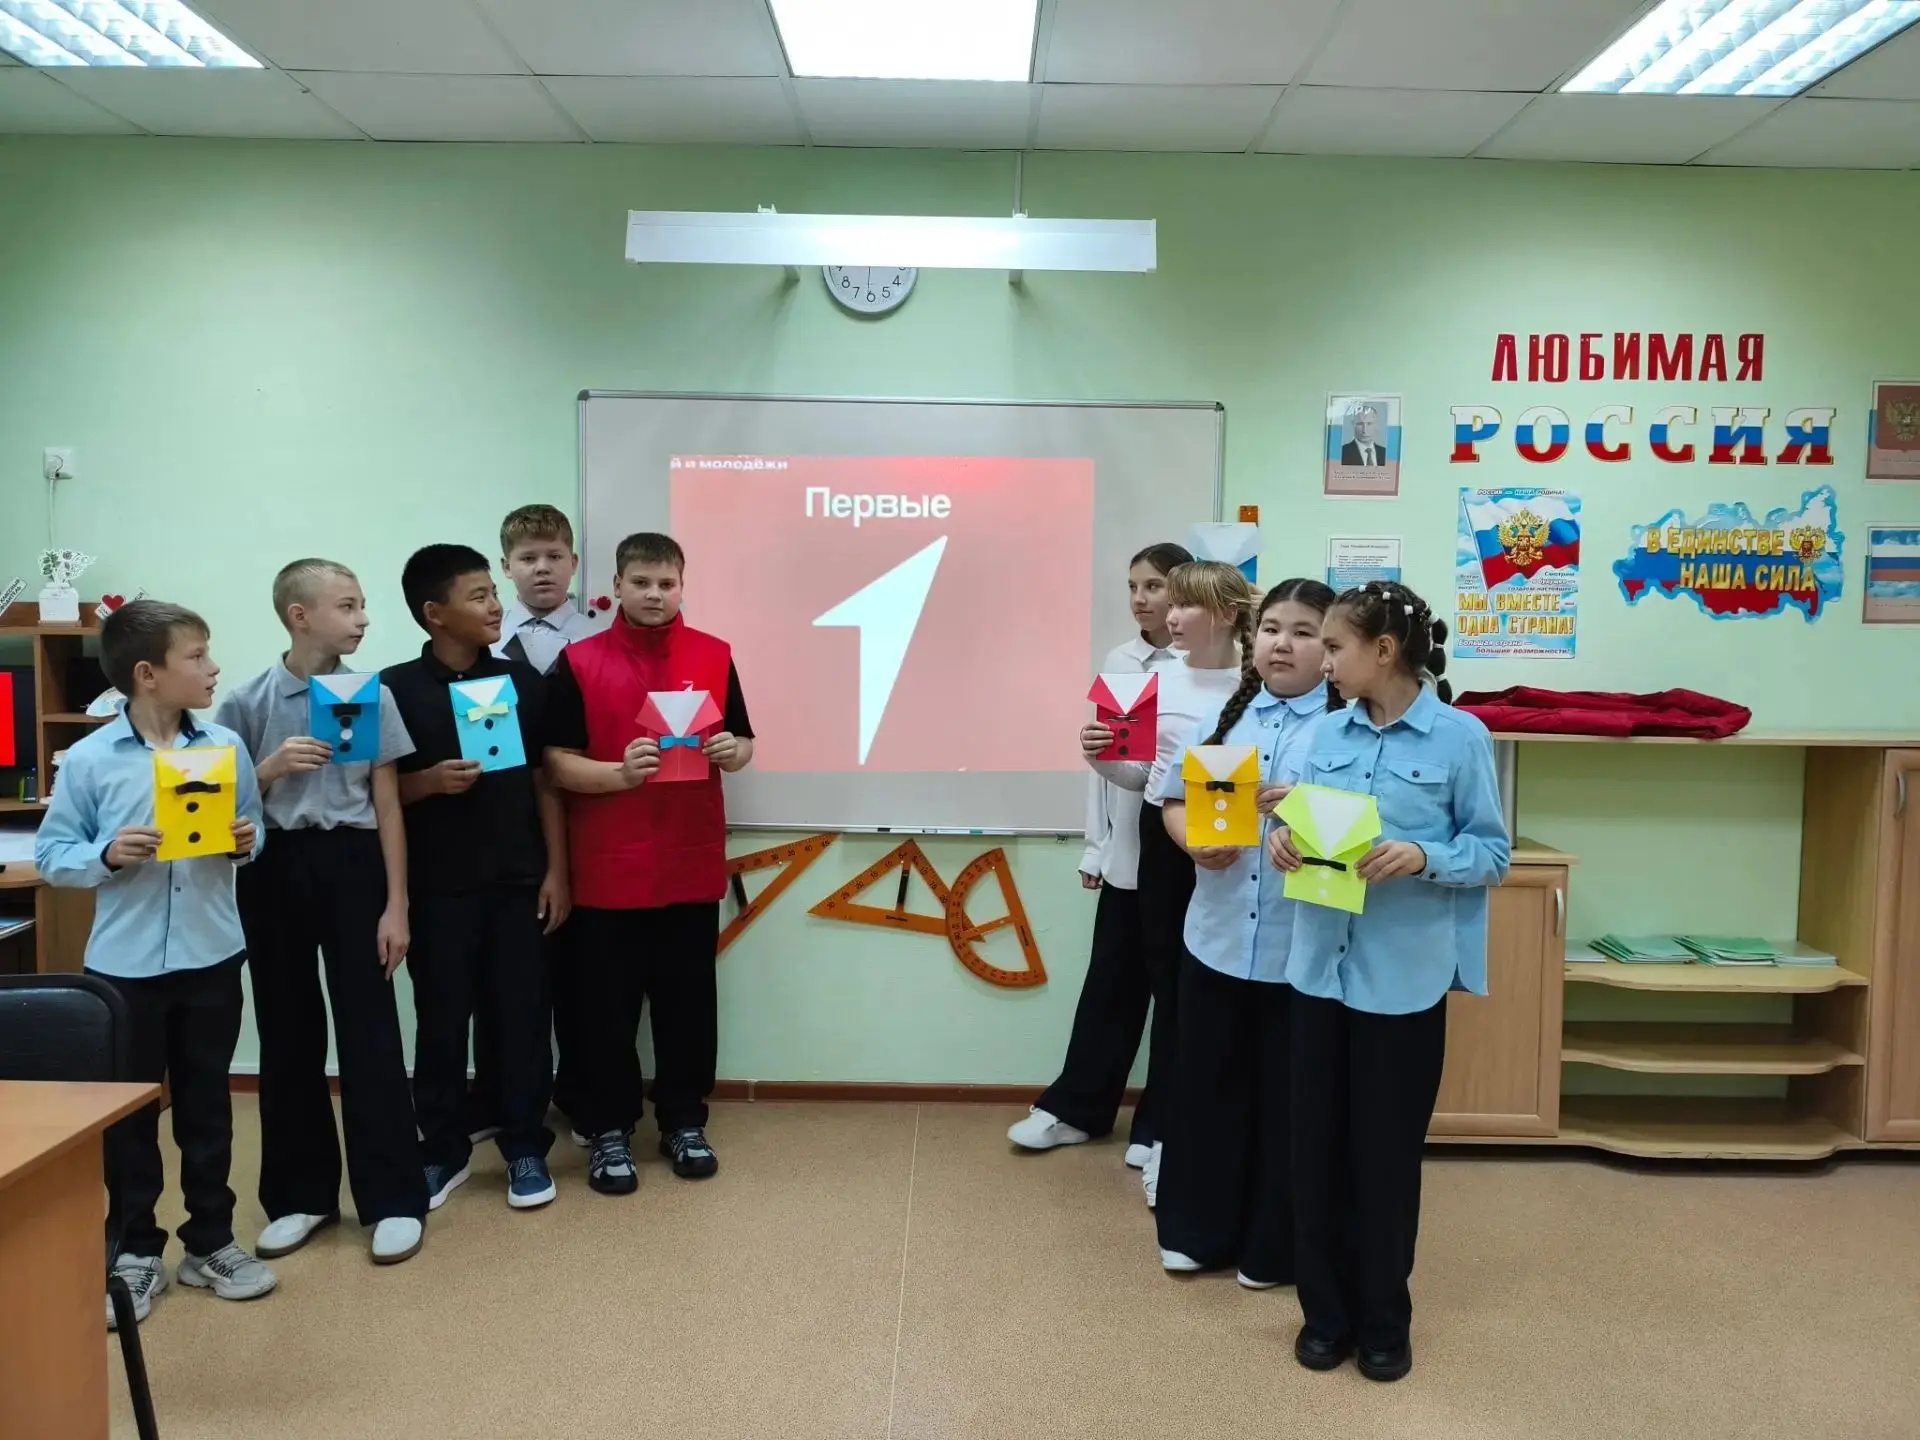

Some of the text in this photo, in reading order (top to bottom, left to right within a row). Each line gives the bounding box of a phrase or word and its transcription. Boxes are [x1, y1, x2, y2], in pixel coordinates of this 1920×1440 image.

[841, 276, 850, 288] 8
[892, 275, 901, 288] 4
[852, 286, 860, 299] 7
[866, 290, 876, 303] 6
[882, 286, 891, 299] 5
[1491, 333, 1765, 383] ЛЮБИМАЯ
[1449, 404, 1837, 466] РОССИЯ
[700, 457, 788, 471] молодёжи
[1477, 488, 1503, 496] РОССИЯ
[805, 486, 952, 528] Первые
[1646, 527, 1785, 559] В ЕДИНСТВЕ
[1680, 562, 1816, 592] НАША СИЛА
[1458, 592, 1489, 612] МЫ
[1496, 593, 1561, 612] ВМЕСТЕ
[1457, 615, 1575, 637] ОДНА СТРАНА!
